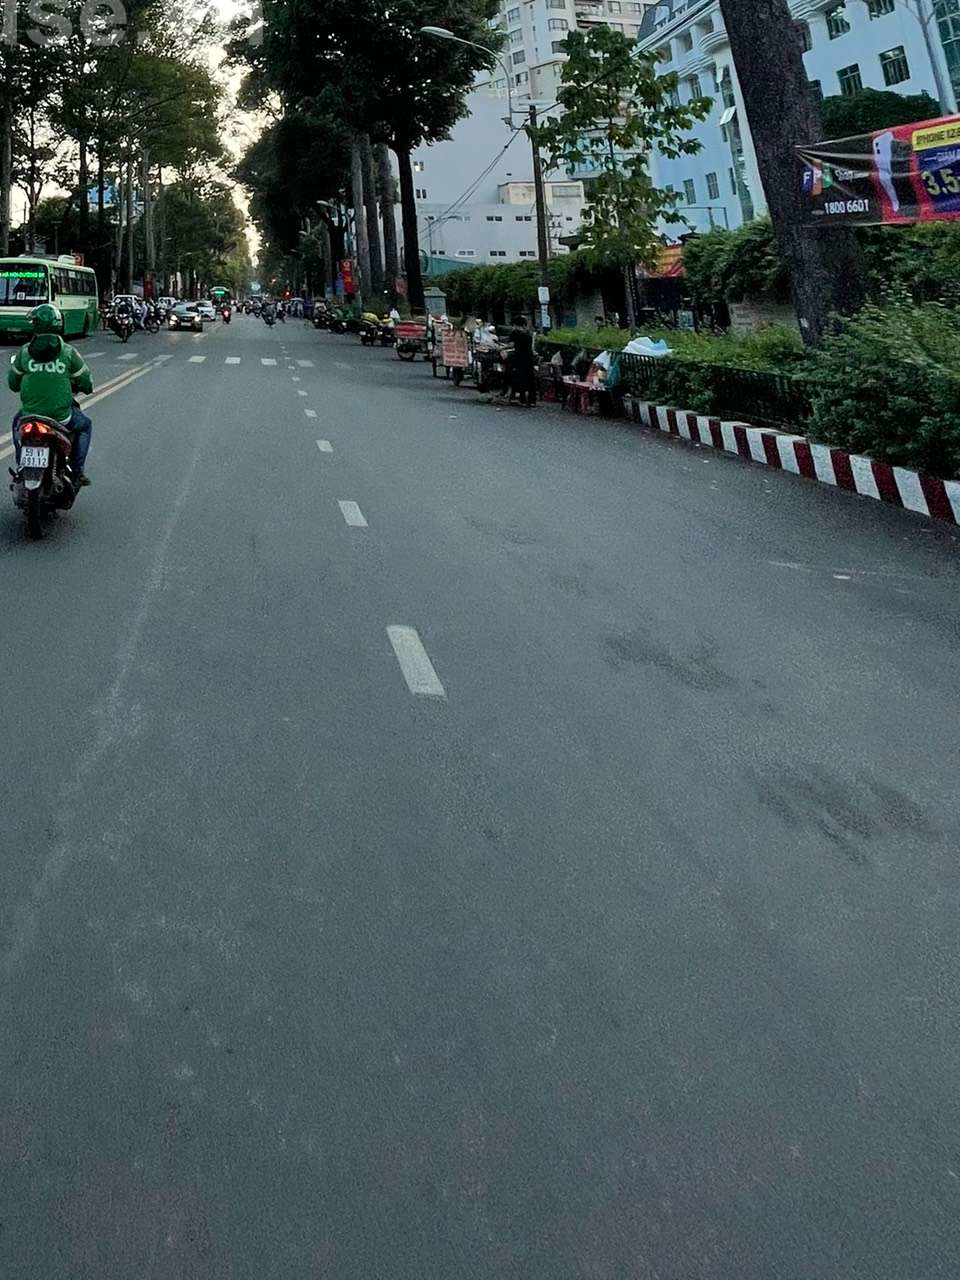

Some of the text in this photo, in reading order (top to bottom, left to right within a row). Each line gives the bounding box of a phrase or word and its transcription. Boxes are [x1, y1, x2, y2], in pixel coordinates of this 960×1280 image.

[824, 201, 846, 215] 1800
[846, 198, 869, 213] 6601
[28, 358, 67, 375] Grab
